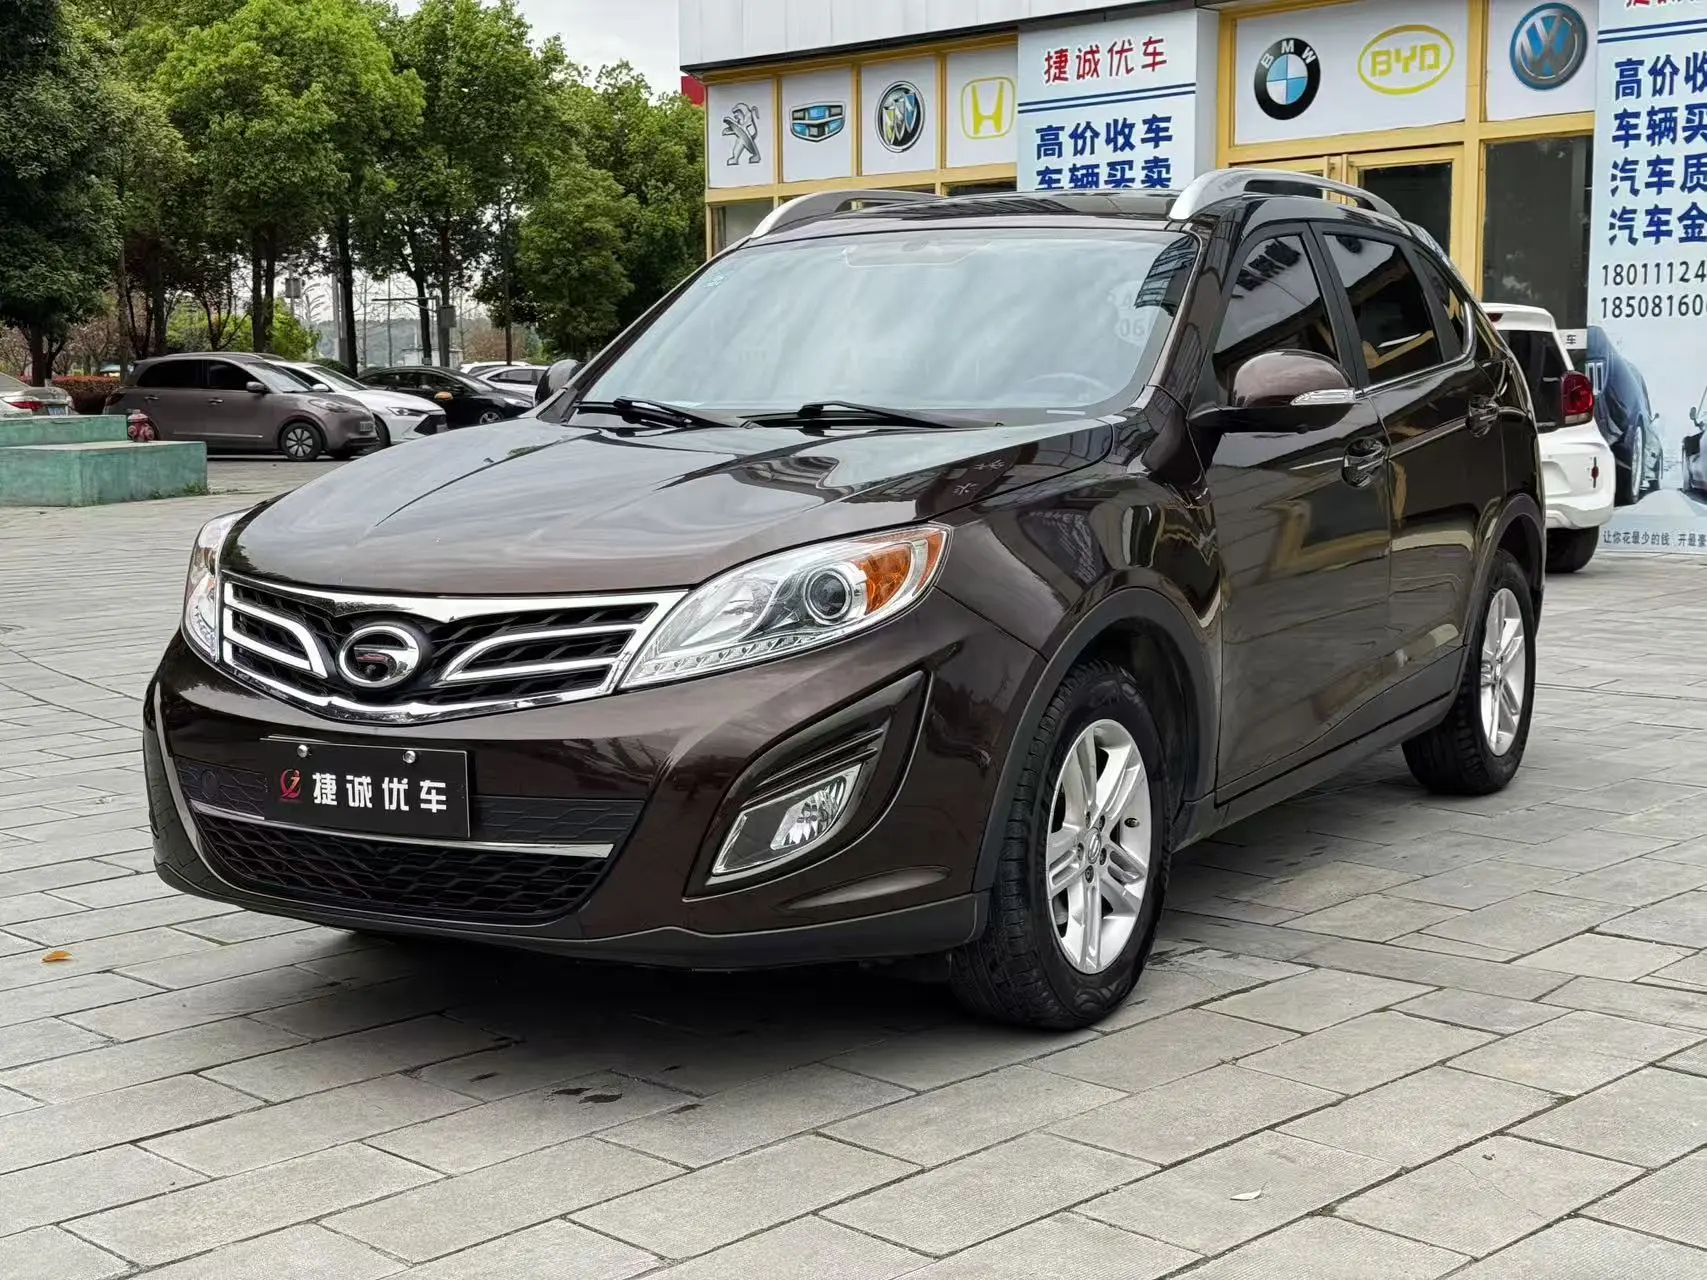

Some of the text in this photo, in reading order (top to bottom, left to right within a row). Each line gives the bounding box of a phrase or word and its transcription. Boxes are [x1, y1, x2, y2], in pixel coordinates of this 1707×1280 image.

[1043, 36, 1168, 85] 捷诚优车
[1260, 39, 1317, 69] BMW
[1370, 42, 1442, 78] BYD
[1614, 50, 1707, 101] 高价收
[1034, 113, 1174, 161] 高价收车
[1611, 102, 1707, 149] 车辆买
[1034, 155, 1173, 191] 车辆买卖
[1609, 152, 1707, 198] 汽车质
[1607, 201, 1707, 247] 汽车金
[1602, 259, 1707, 287] 18011124
[1600, 293, 1707, 319] 18508160
[311, 771, 448, 814] 捷诚优车
